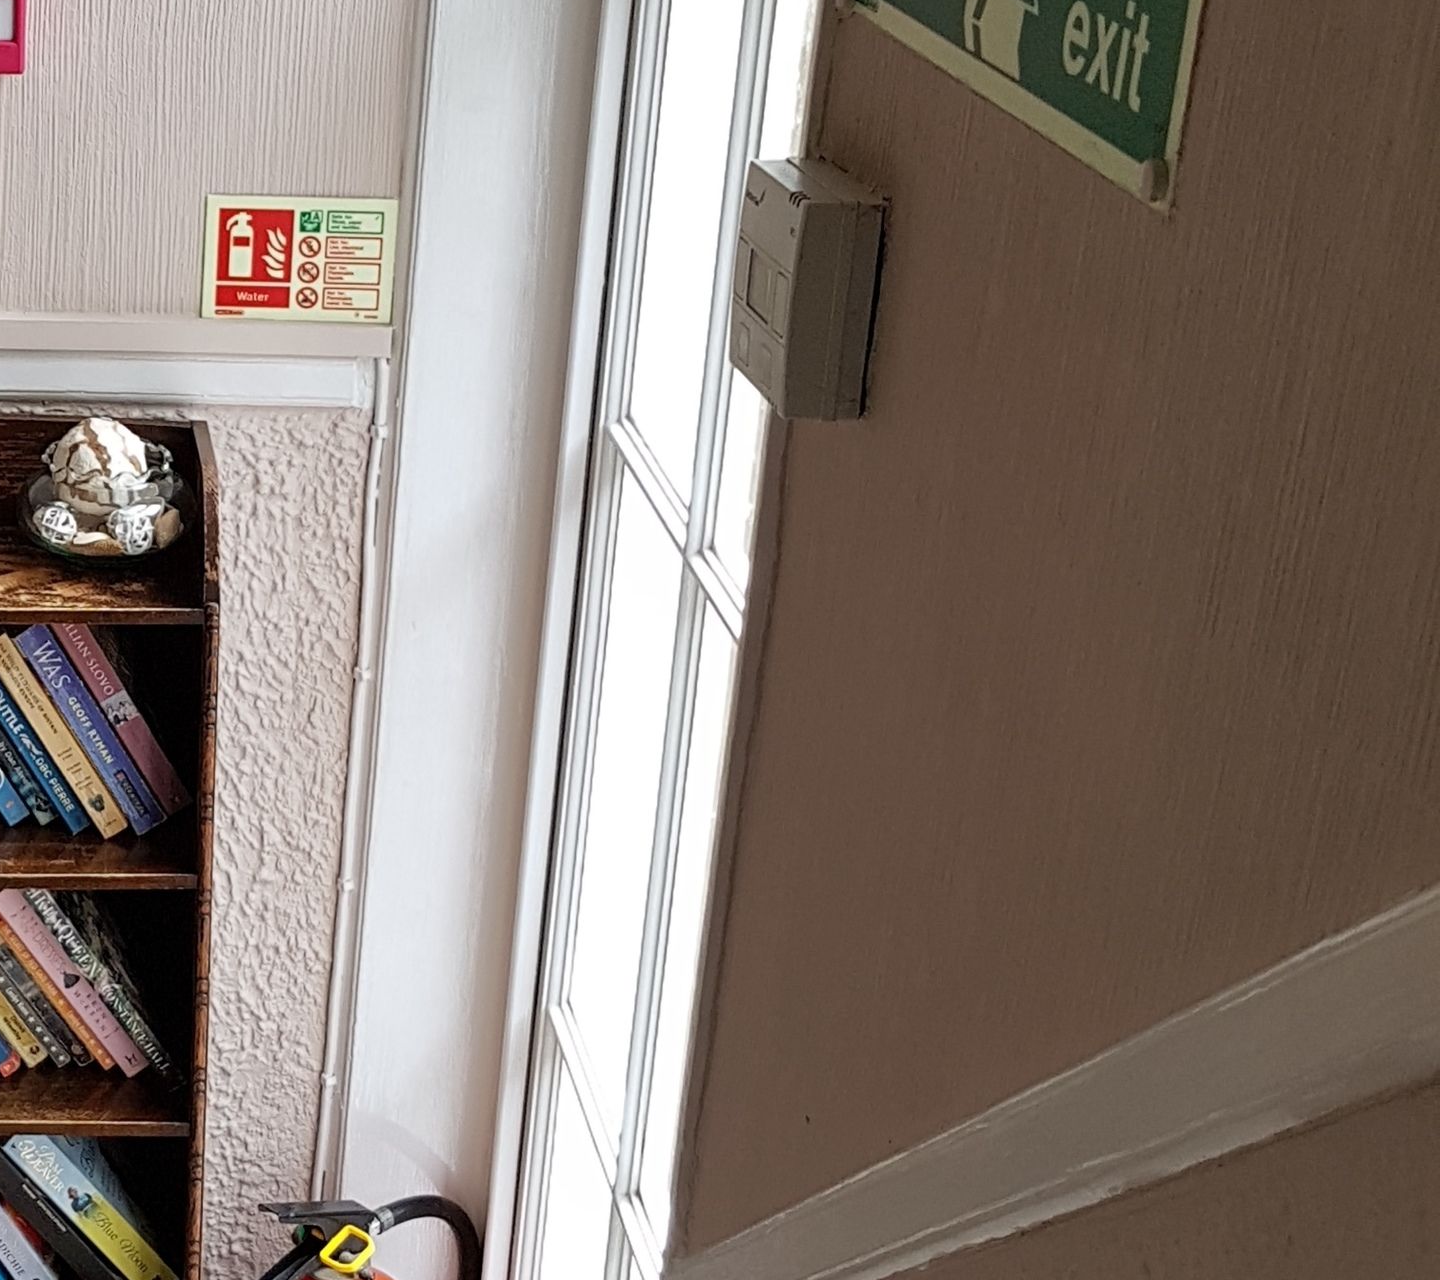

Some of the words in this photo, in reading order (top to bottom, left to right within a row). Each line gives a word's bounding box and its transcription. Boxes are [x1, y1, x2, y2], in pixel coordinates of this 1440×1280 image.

[1061, 0, 1151, 114] exit
[236, 291, 269, 303] Water
[30, 639, 73, 691] WAS
[84, 656, 115, 696] SLOVO
[3, 750, 18, 766] Dan
[66, 695, 92, 729] GEOFF
[86, 728, 114, 764] RYMAN
[34, 755, 54, 778] DBC
[47, 776, 75, 813] PIERRE
[52, 922, 103, 979] QUEEN
[99, 981, 150, 1046] CONSTANCE
[143, 1041, 172, 1074] HALL
[90, 1210, 121, 1242] Blue
[117, 1236, 151, 1274] Moon
